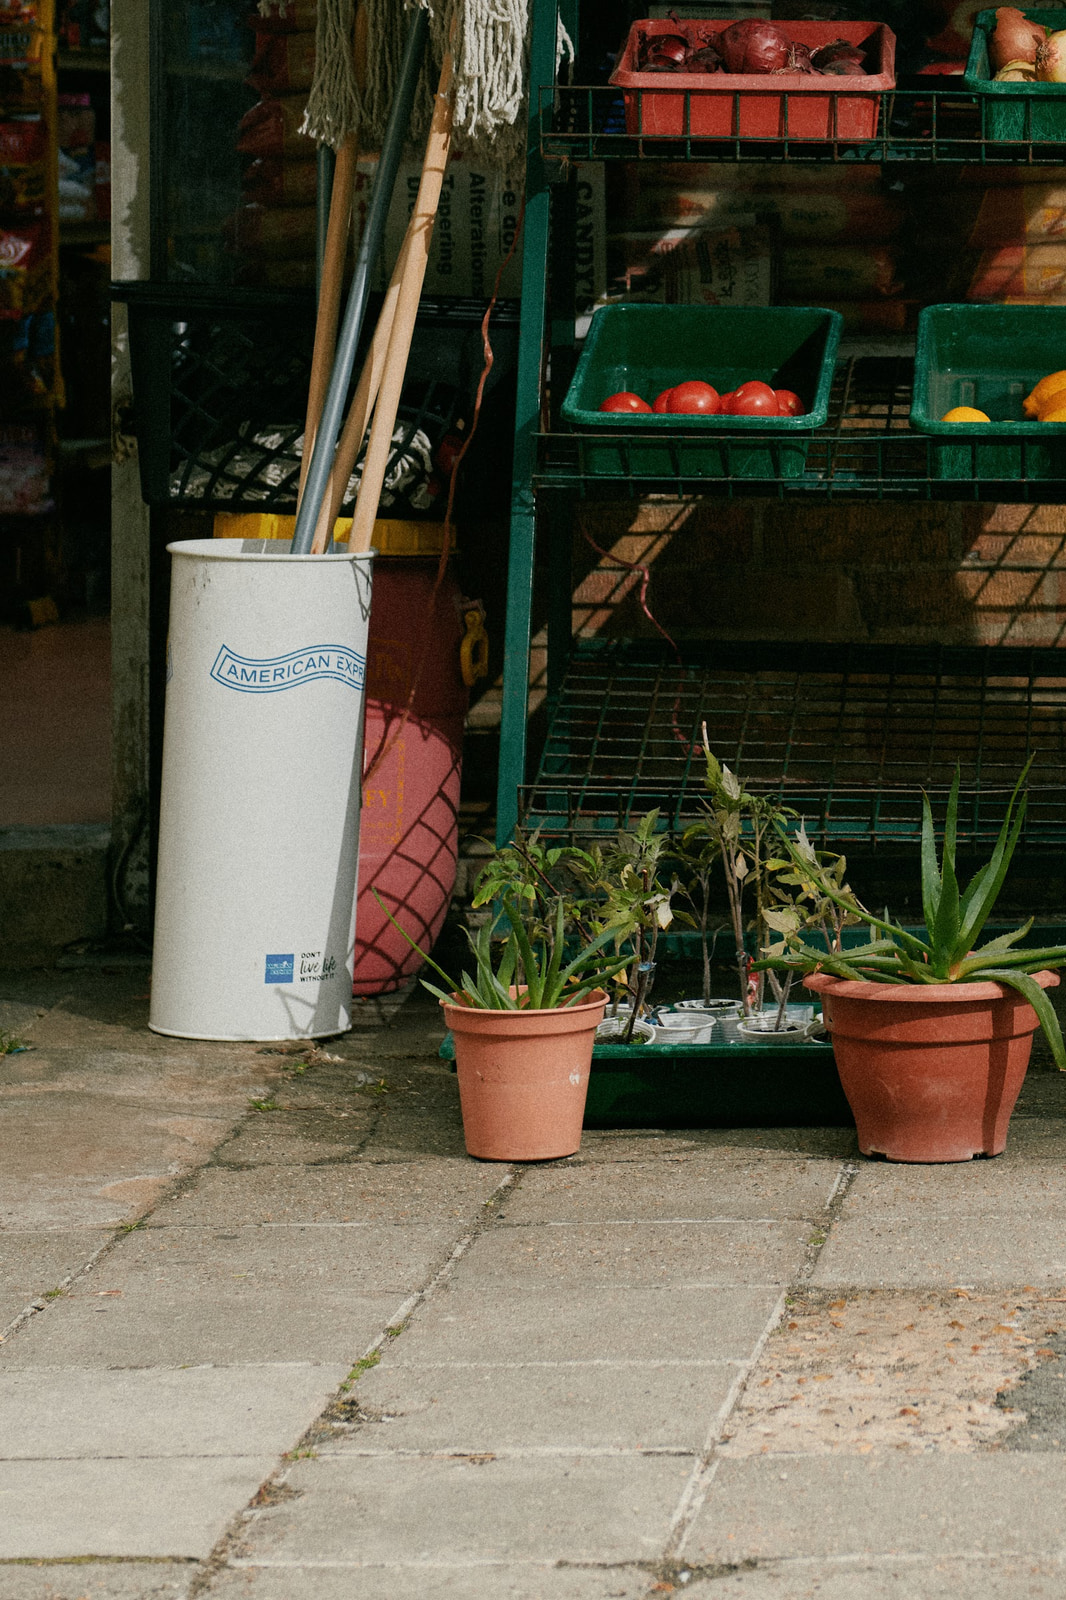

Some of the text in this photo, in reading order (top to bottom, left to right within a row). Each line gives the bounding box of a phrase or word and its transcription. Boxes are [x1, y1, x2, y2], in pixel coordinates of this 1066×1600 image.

[436, 174, 455, 276] Tapering
[469, 172, 487, 297] Alterations
[575, 181, 595, 313] CANDY'S
[227, 654, 331, 683] AMERICAN
[299, 960, 320, 975] live
[322, 955, 337, 973] life
